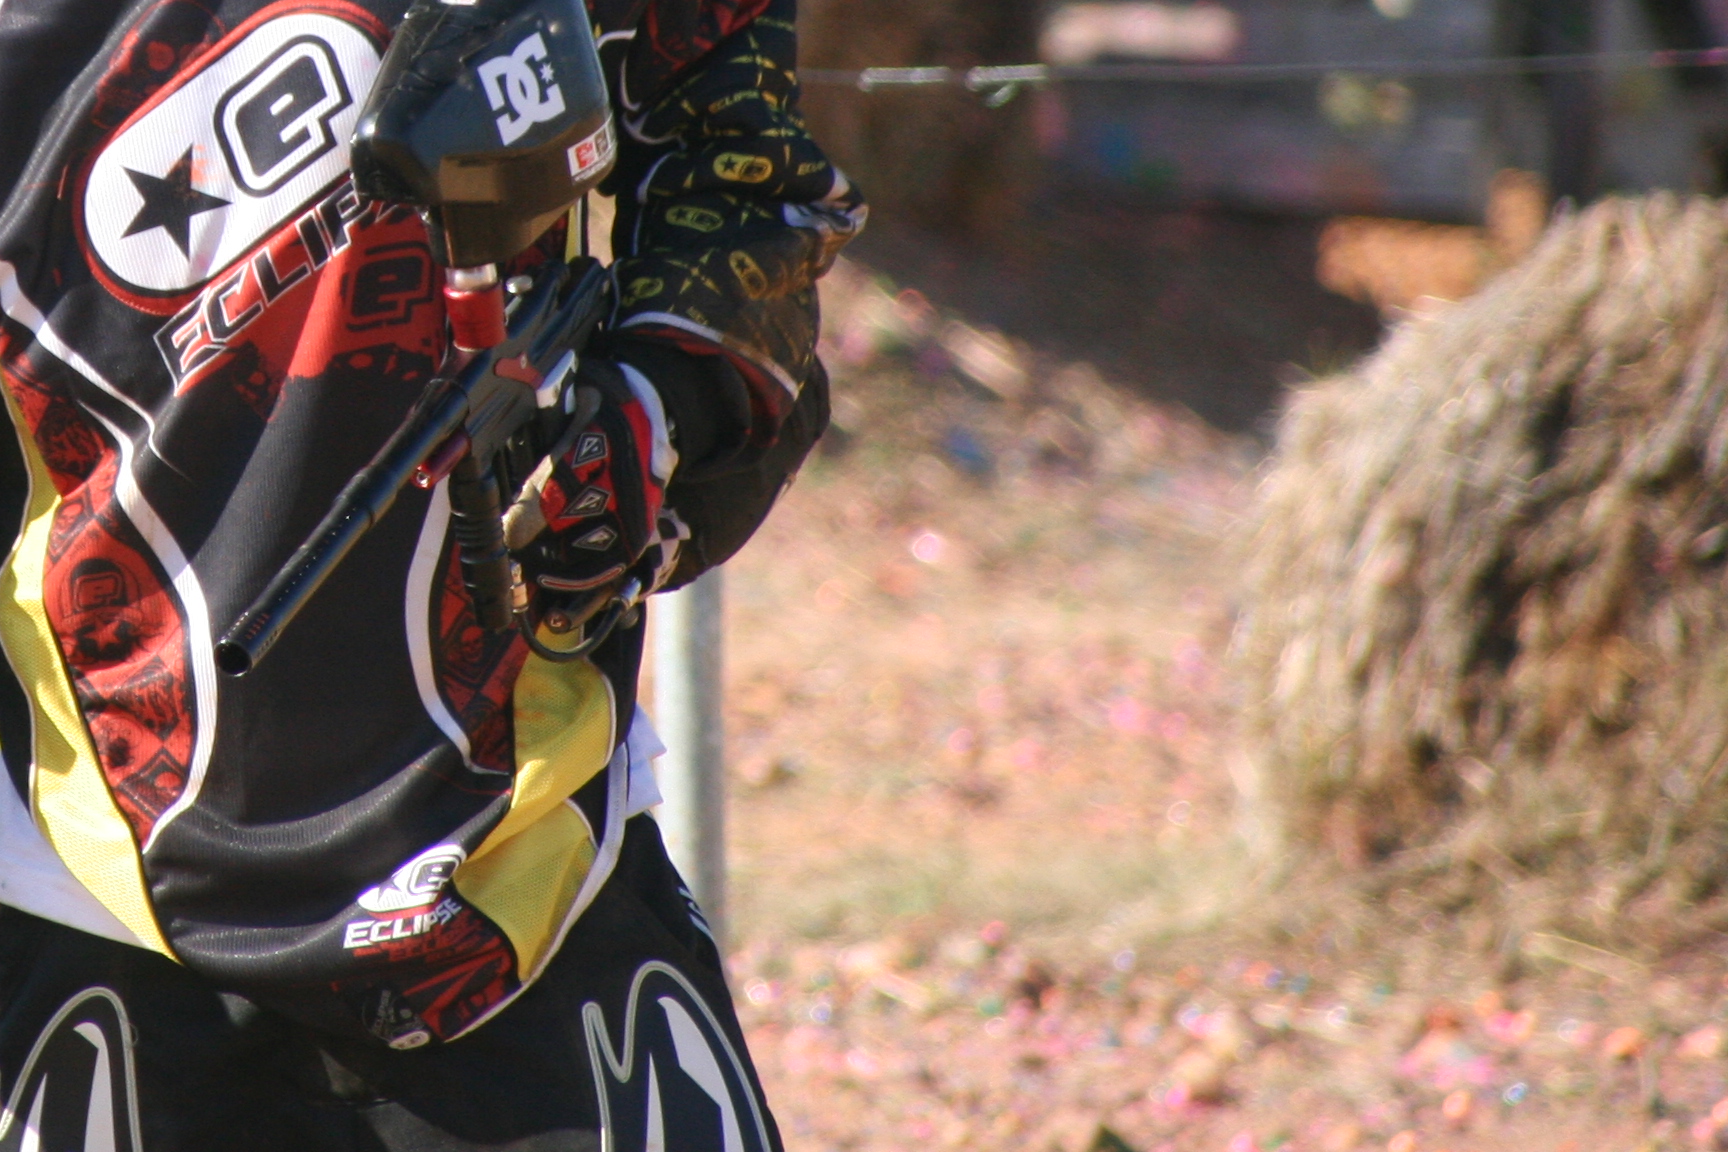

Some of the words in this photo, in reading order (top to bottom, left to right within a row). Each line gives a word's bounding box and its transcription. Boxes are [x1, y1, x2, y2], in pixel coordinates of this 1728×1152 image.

[477, 32, 566, 146] DC
[154, 173, 399, 396] ECLIP
[343, 897, 462, 949] ECLIPSE
